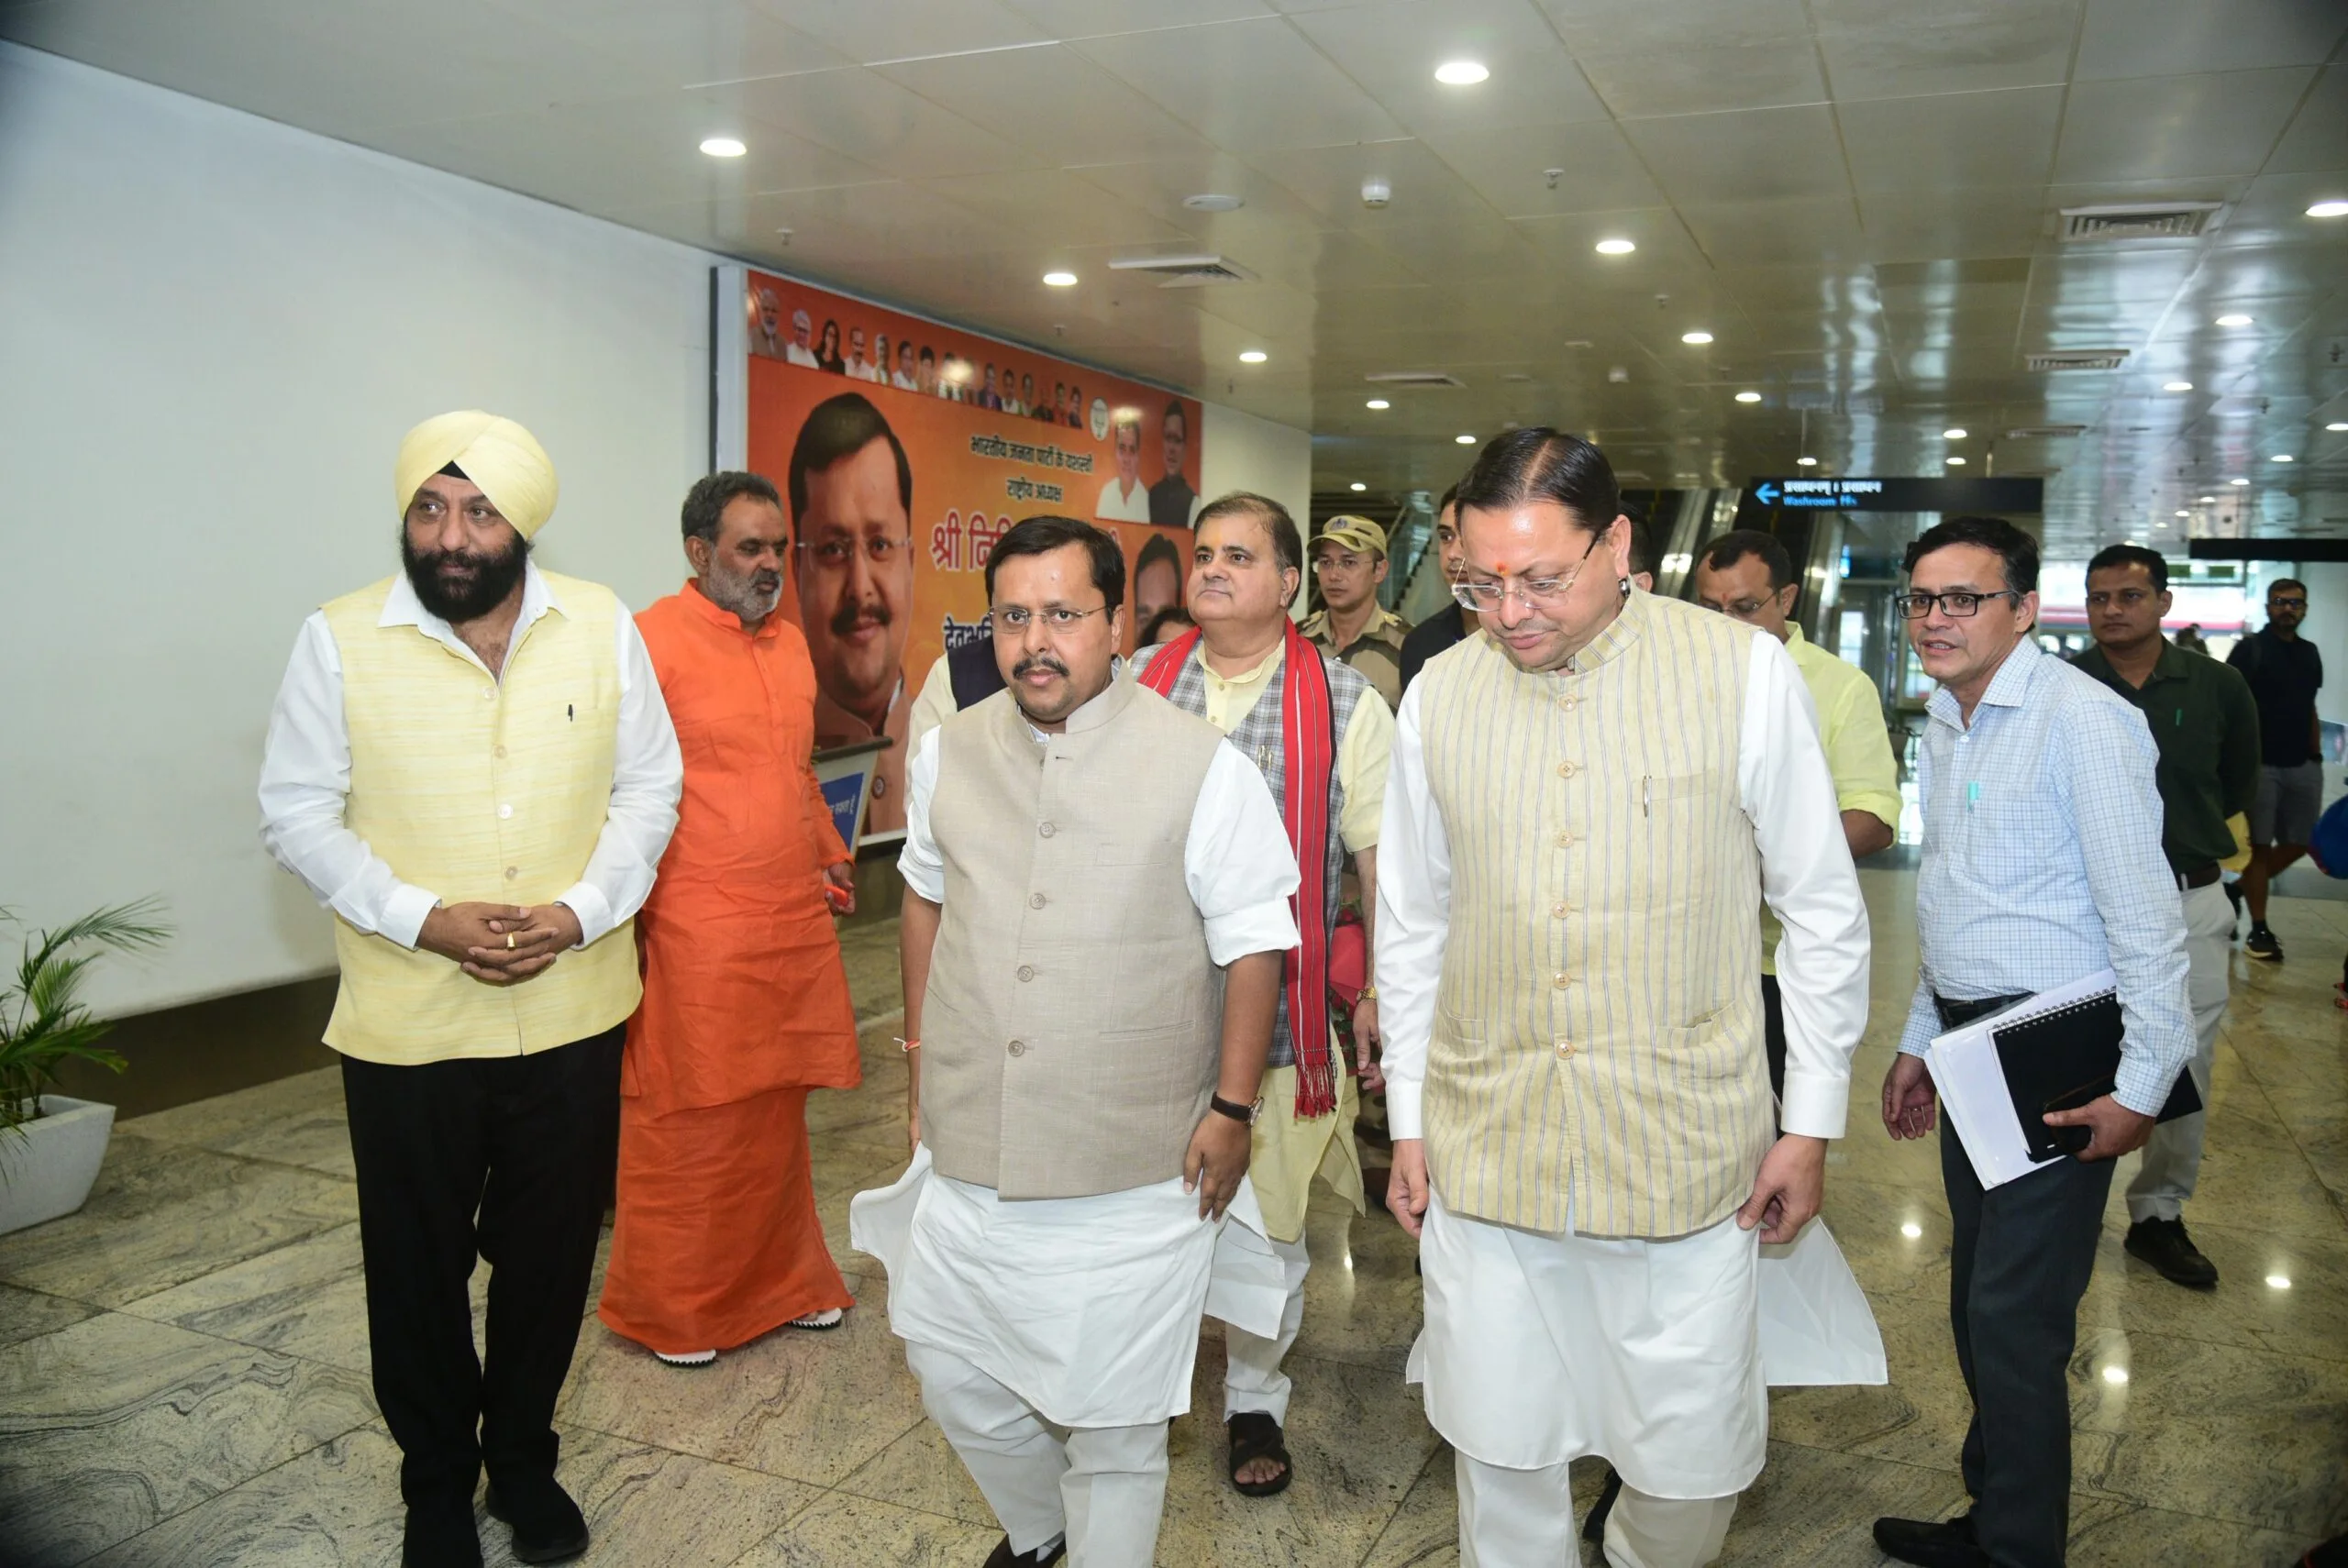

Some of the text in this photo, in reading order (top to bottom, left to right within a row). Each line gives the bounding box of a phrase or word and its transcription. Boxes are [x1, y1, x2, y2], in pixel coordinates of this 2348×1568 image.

[970, 434, 1007, 459] भारतीय
[1008, 442, 1036, 463] जनता
[1783, 495, 1837, 505] Washroom
[932, 511, 961, 569] श्री
